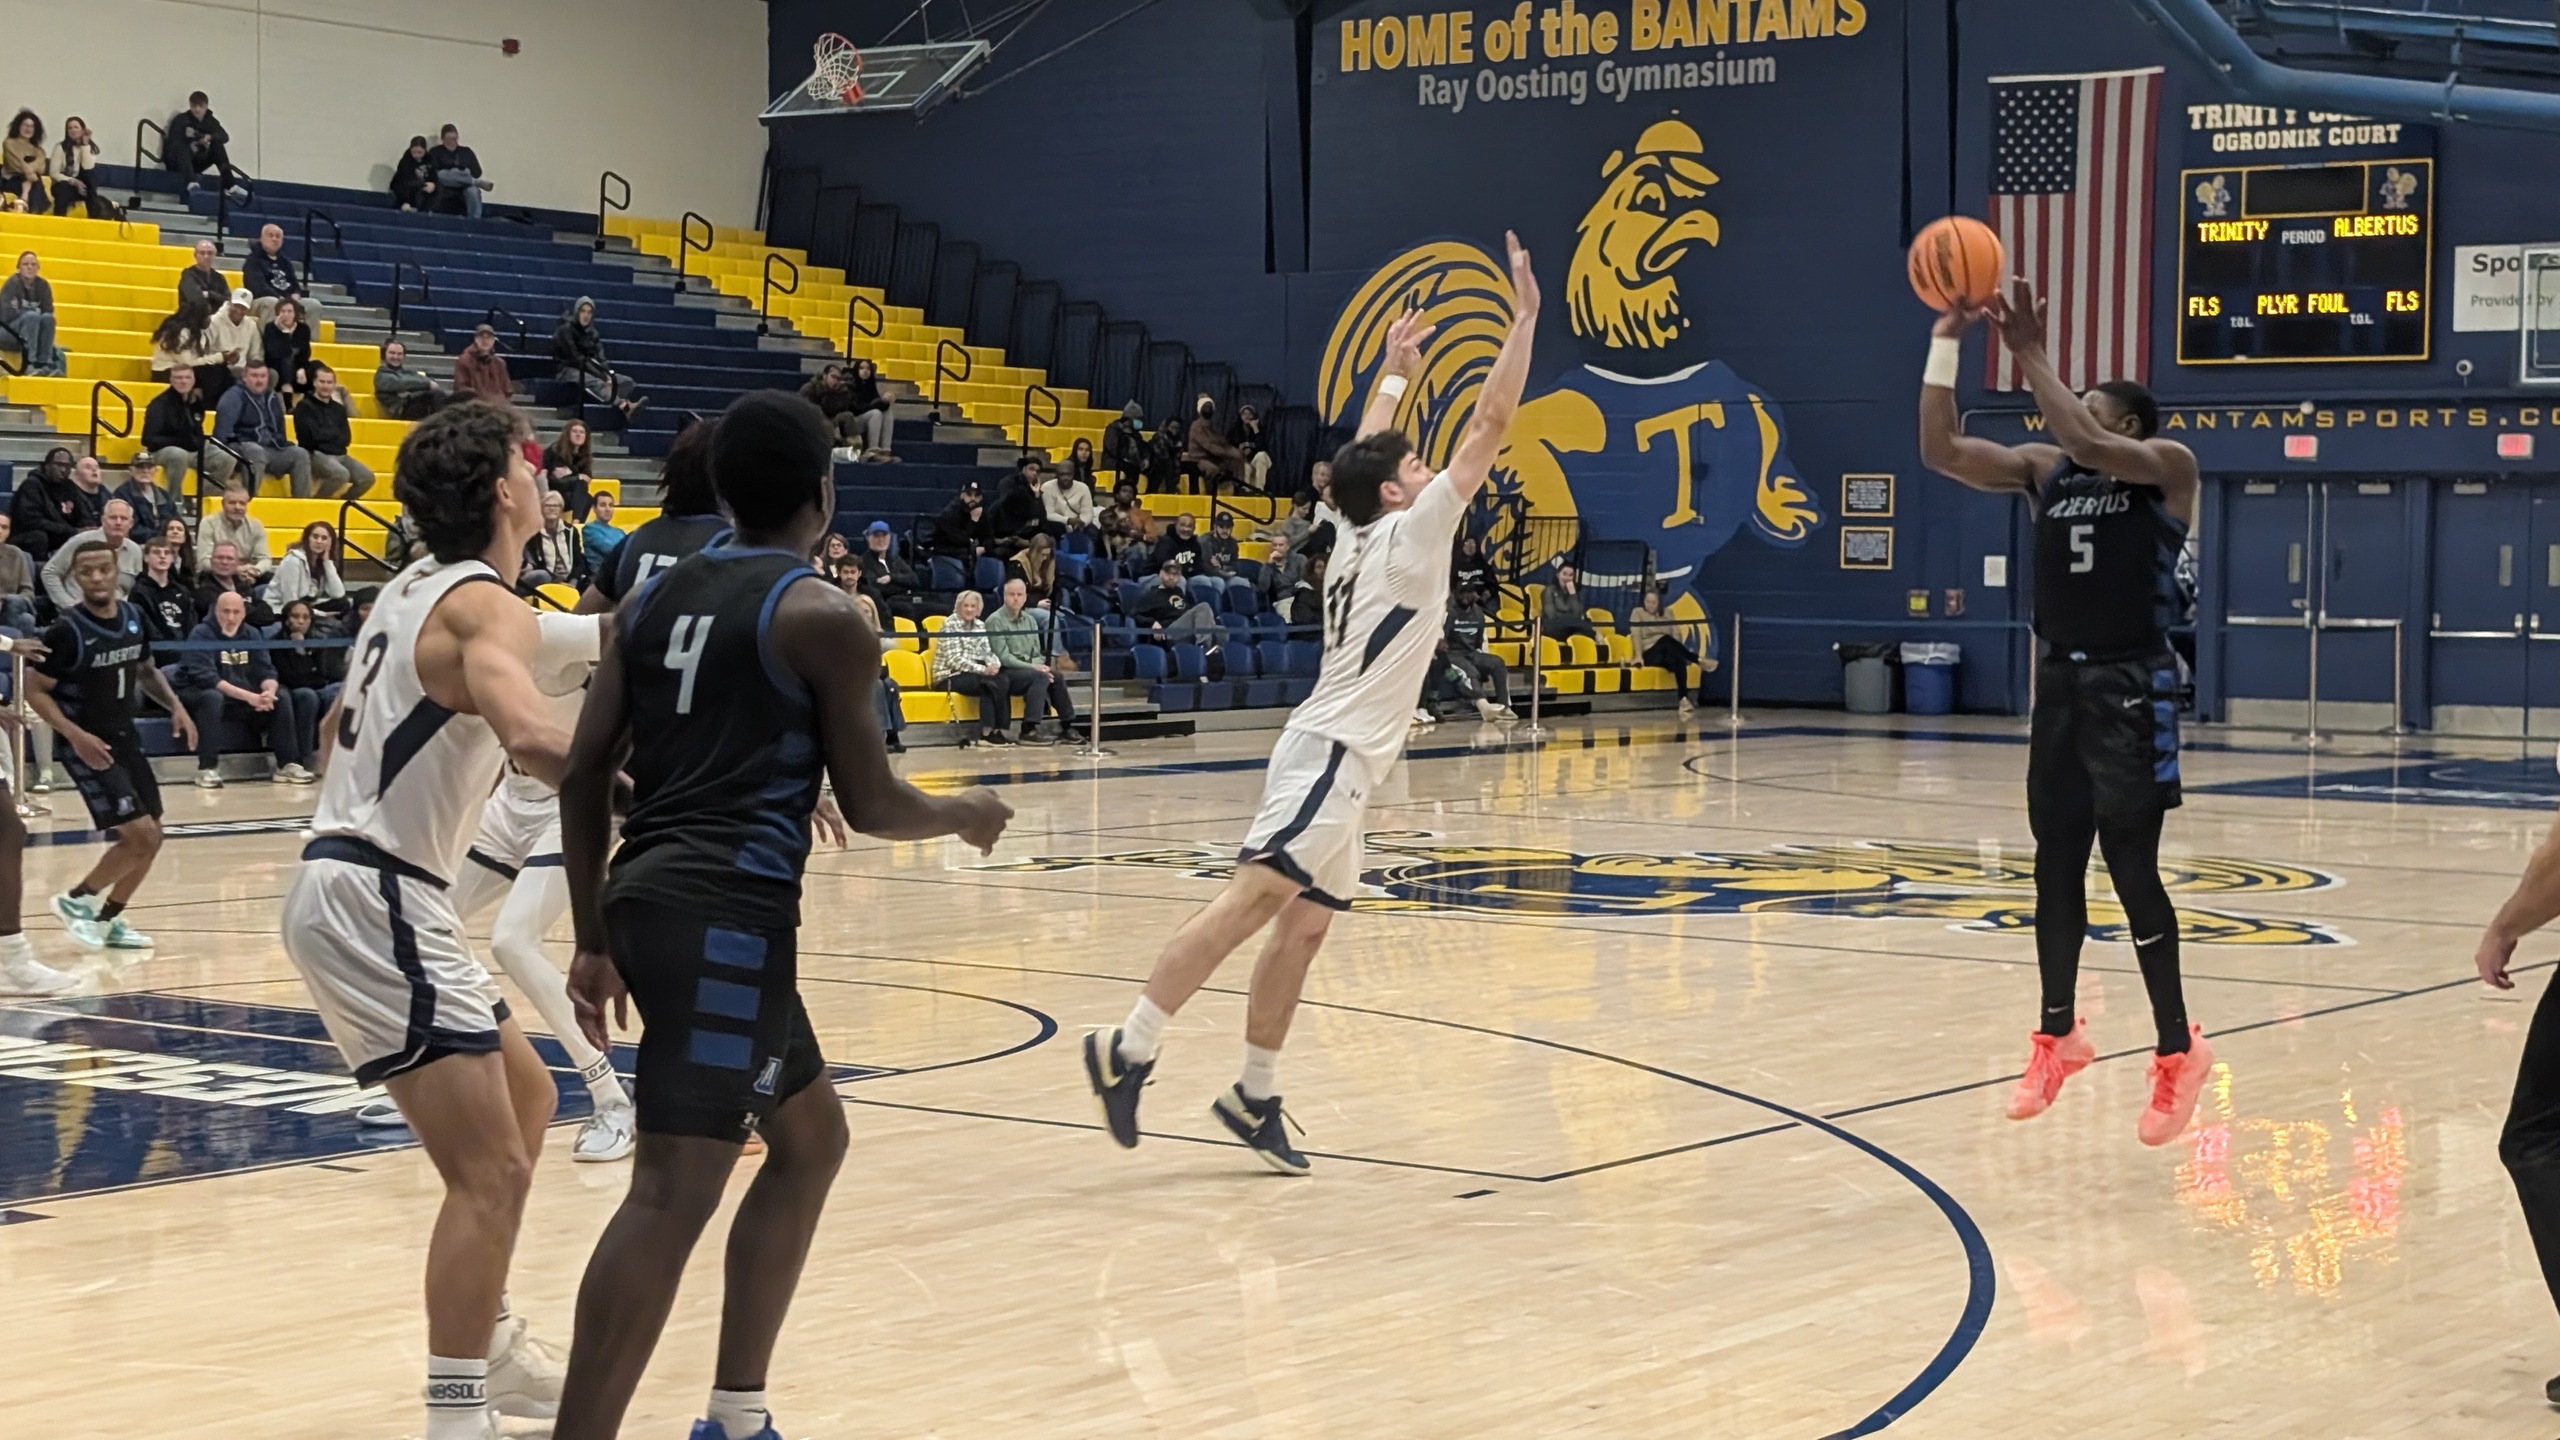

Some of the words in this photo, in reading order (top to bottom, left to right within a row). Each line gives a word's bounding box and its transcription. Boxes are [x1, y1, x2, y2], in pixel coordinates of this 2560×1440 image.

[1341, 11, 1473, 72] HOME
[1484, 1, 1532, 62] of
[1540, 0, 1619, 58] the
[1631, 0, 1867, 51] BANTAMS
[1418, 74, 1469, 113] Ray
[1476, 64, 1588, 105] Oosting
[1596, 51, 1776, 103] Gymnasium
[2212, 128, 2322, 152] OGRODNIK
[2328, 124, 2402, 146] COURT
[2198, 220, 2269, 243] TRINITY
[2281, 230, 2326, 244] PERIOD
[2334, 215, 2419, 237] ALBERTUS
[2189, 296, 2221, 317] FLS
[2257, 294, 2299, 316] PLYR
[2307, 292, 2350, 314] FOUL
[2386, 290, 2420, 312] FLS
[2070, 524, 2094, 573] 5
[664, 615, 715, 715] 4
[117, 667, 125, 699] 1
[338, 632, 389, 750] 3
